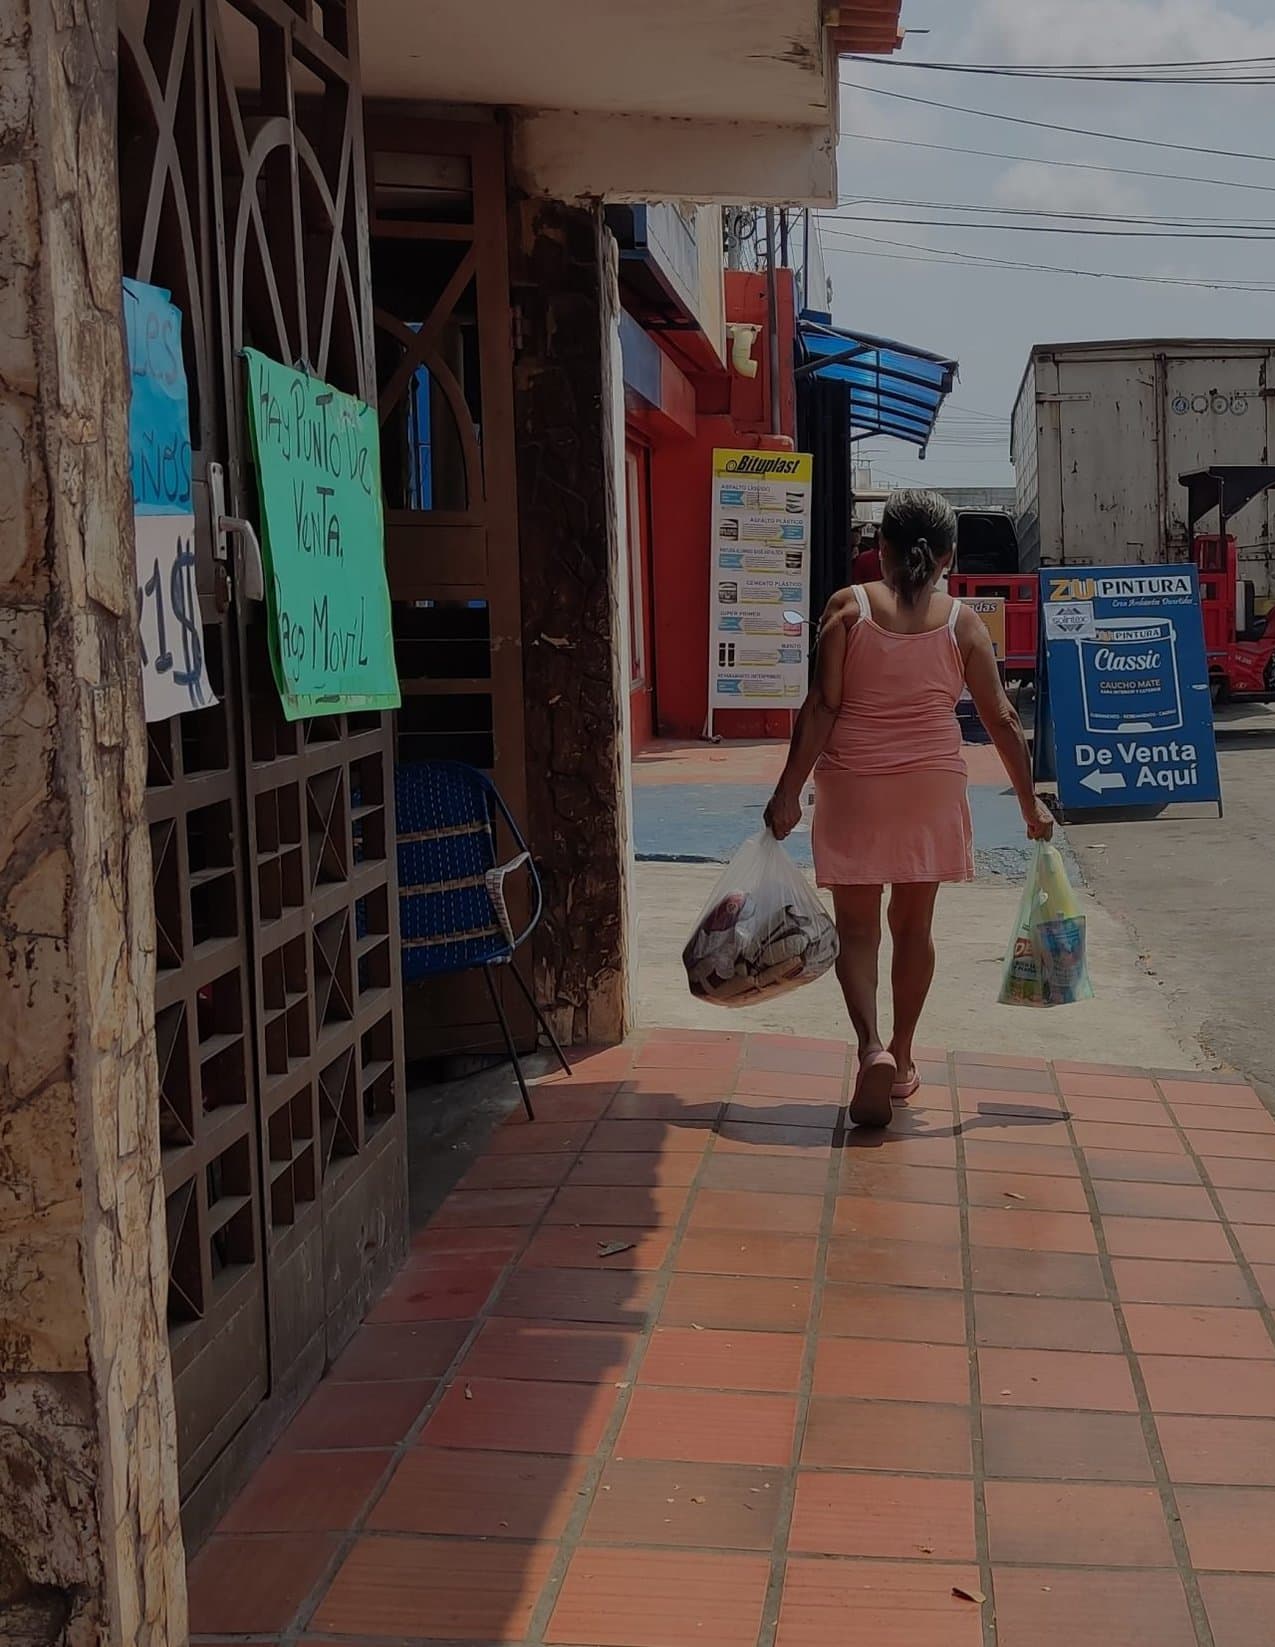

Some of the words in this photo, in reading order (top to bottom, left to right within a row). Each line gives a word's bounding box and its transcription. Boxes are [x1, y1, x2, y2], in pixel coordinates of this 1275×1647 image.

[738, 455, 800, 474] Bituplast
[1102, 577, 1189, 596] PINTURA
[1115, 630, 1160, 640] PINTURA
[1095, 648, 1161, 671] Classic
[1100, 681, 1136, 689] CAUCHO
[1138, 679, 1161, 688] MATE
[1076, 745, 1112, 766] De
[1117, 742, 1197, 764] Venta
[1136, 763, 1198, 791] Aquí
